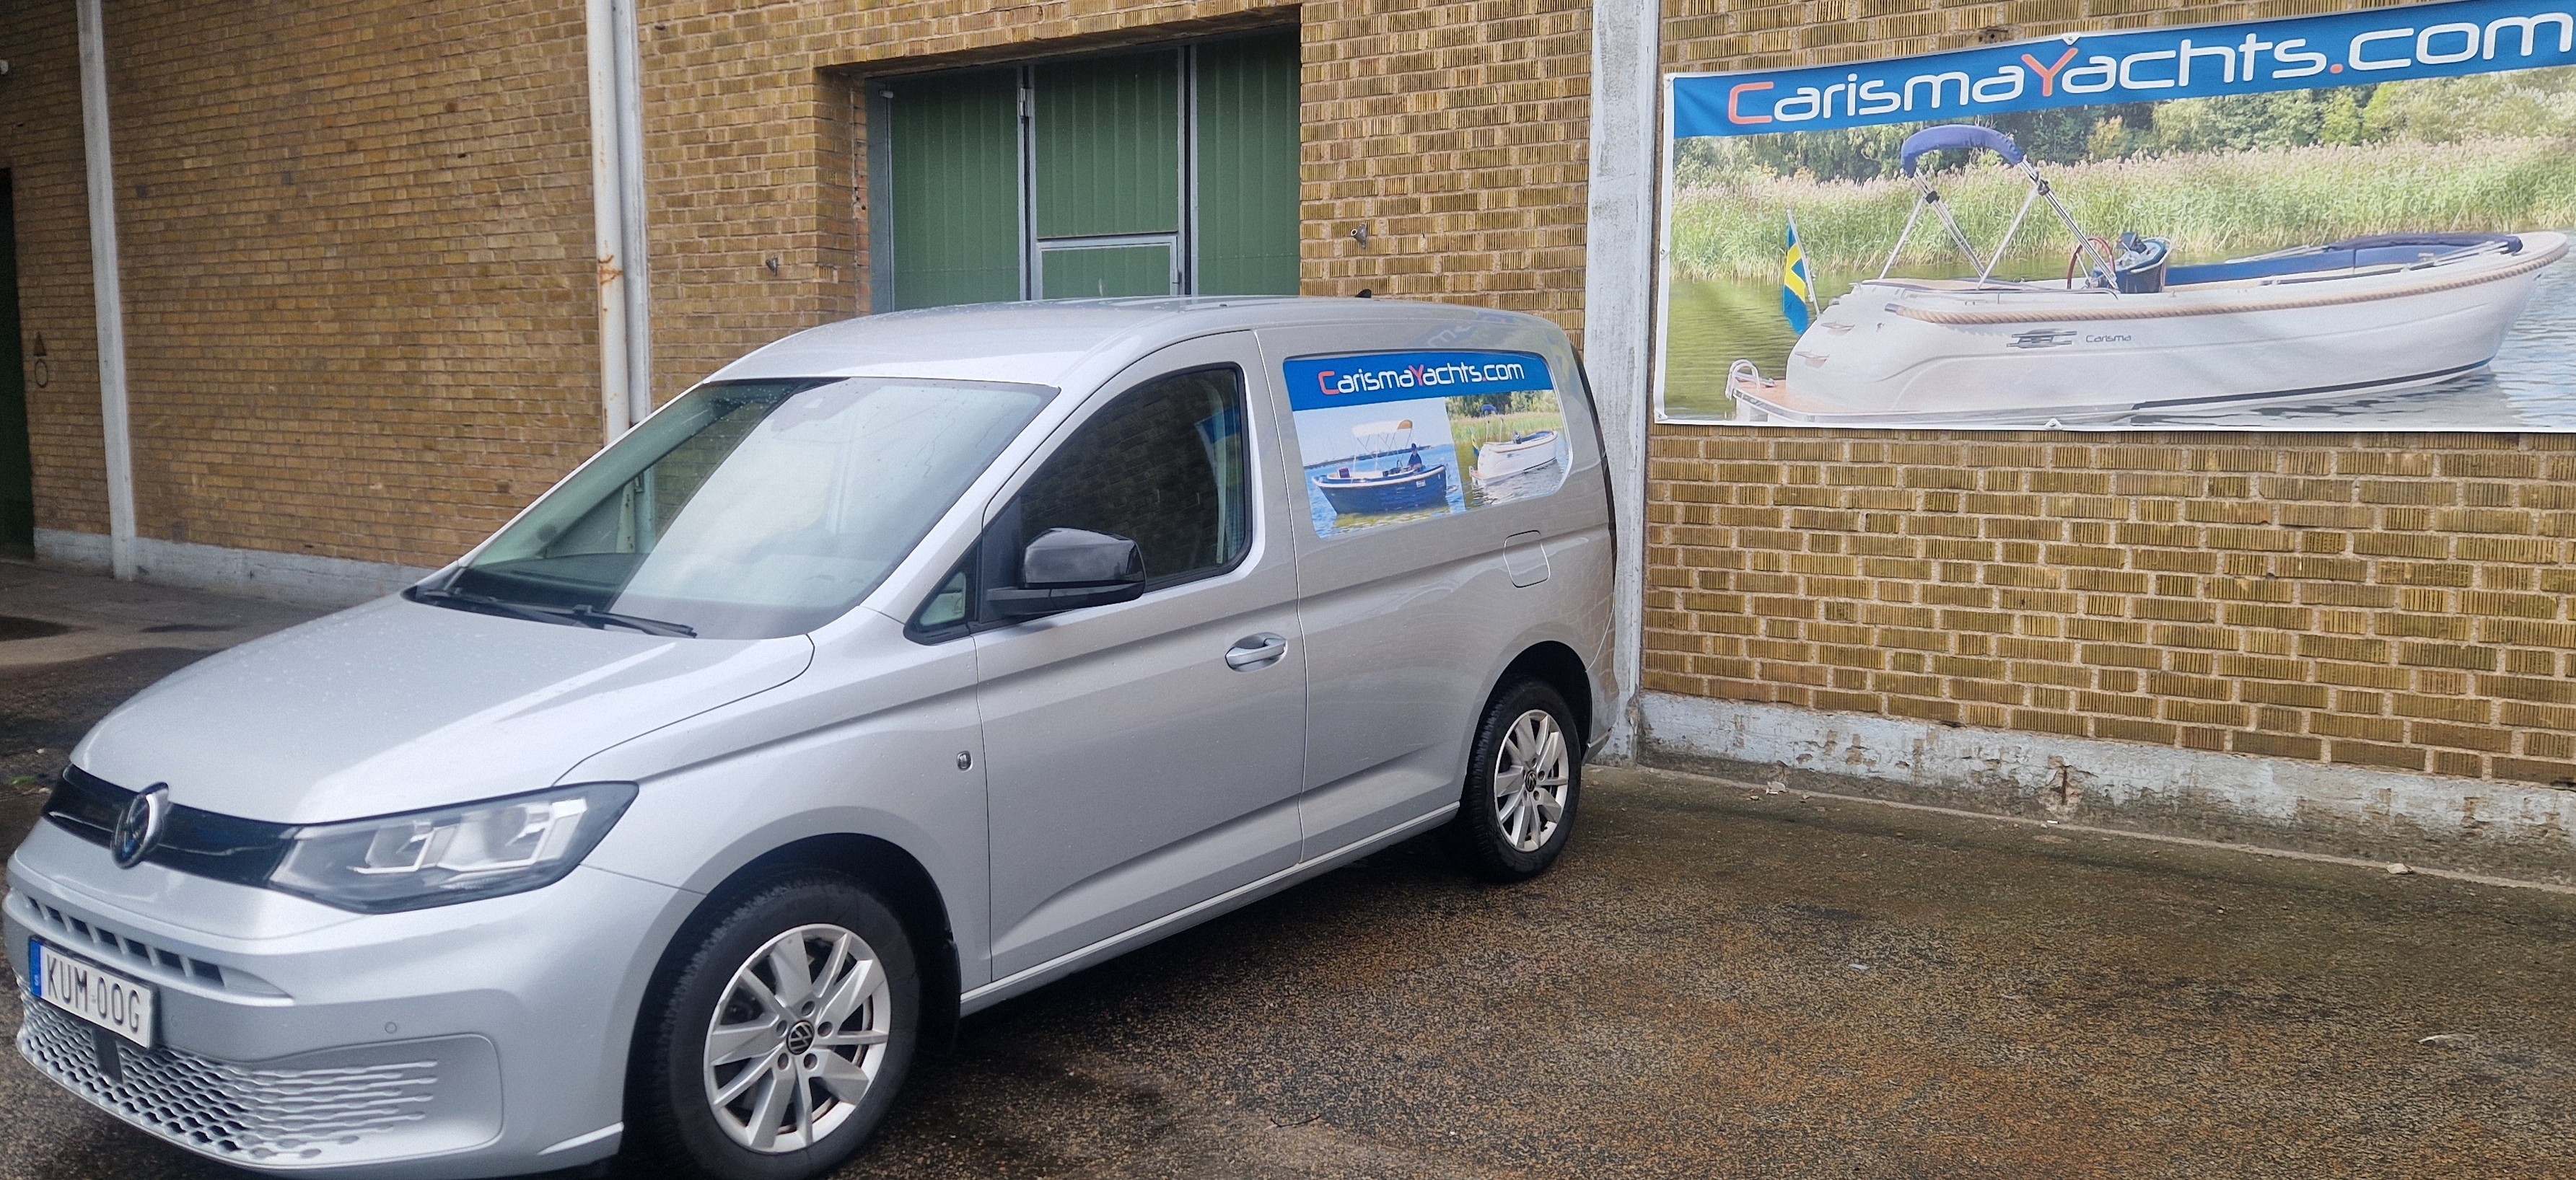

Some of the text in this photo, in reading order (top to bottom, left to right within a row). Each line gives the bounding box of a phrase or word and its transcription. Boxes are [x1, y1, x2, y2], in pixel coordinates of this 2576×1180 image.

[1728, 12, 2575, 126] CarismaYachts.com
[1318, 361, 1525, 395] CarismaYachts.com
[46, 954, 89, 1013] KUM
